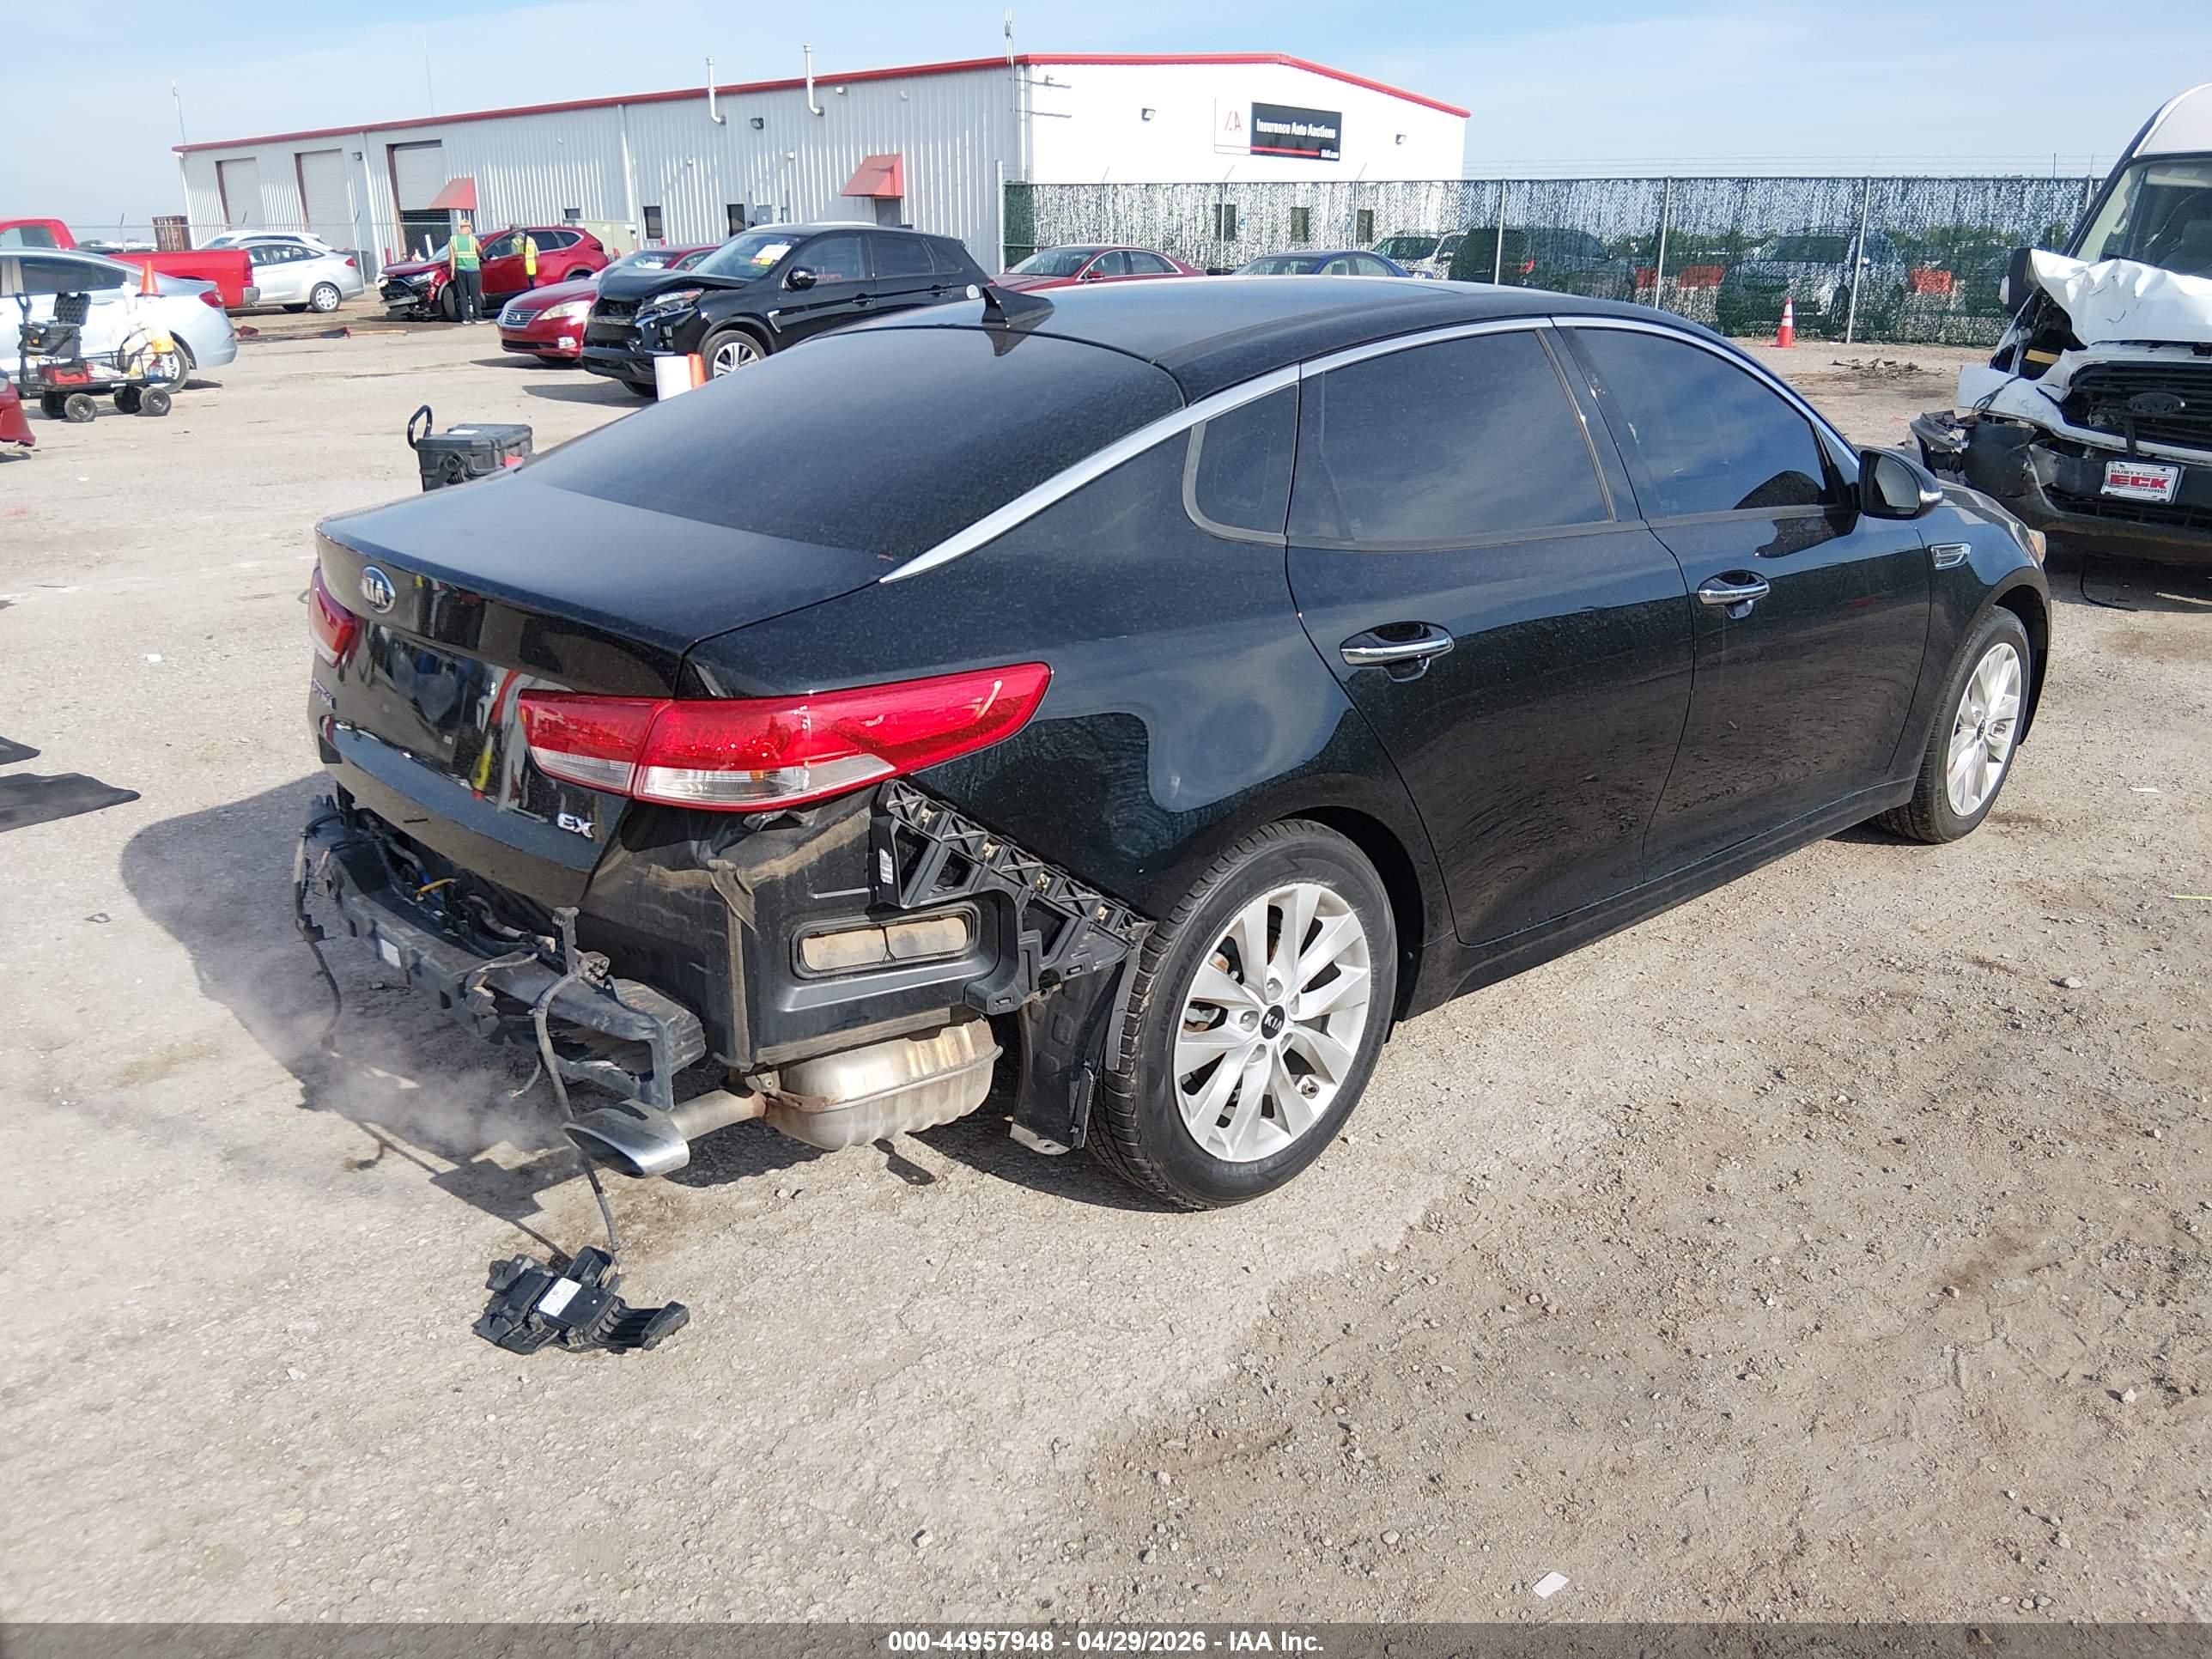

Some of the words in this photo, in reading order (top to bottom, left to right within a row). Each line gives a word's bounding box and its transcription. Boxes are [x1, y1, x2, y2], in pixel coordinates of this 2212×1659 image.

[1256, 118, 1291, 135] Insurance
[1291, 121, 1307, 137] Auto
[1307, 123, 1336, 139] Auctions
[2109, 473, 2171, 489] ECK
[557, 812, 597, 838] EX
[1264, 1013, 1283, 1032] KIA
